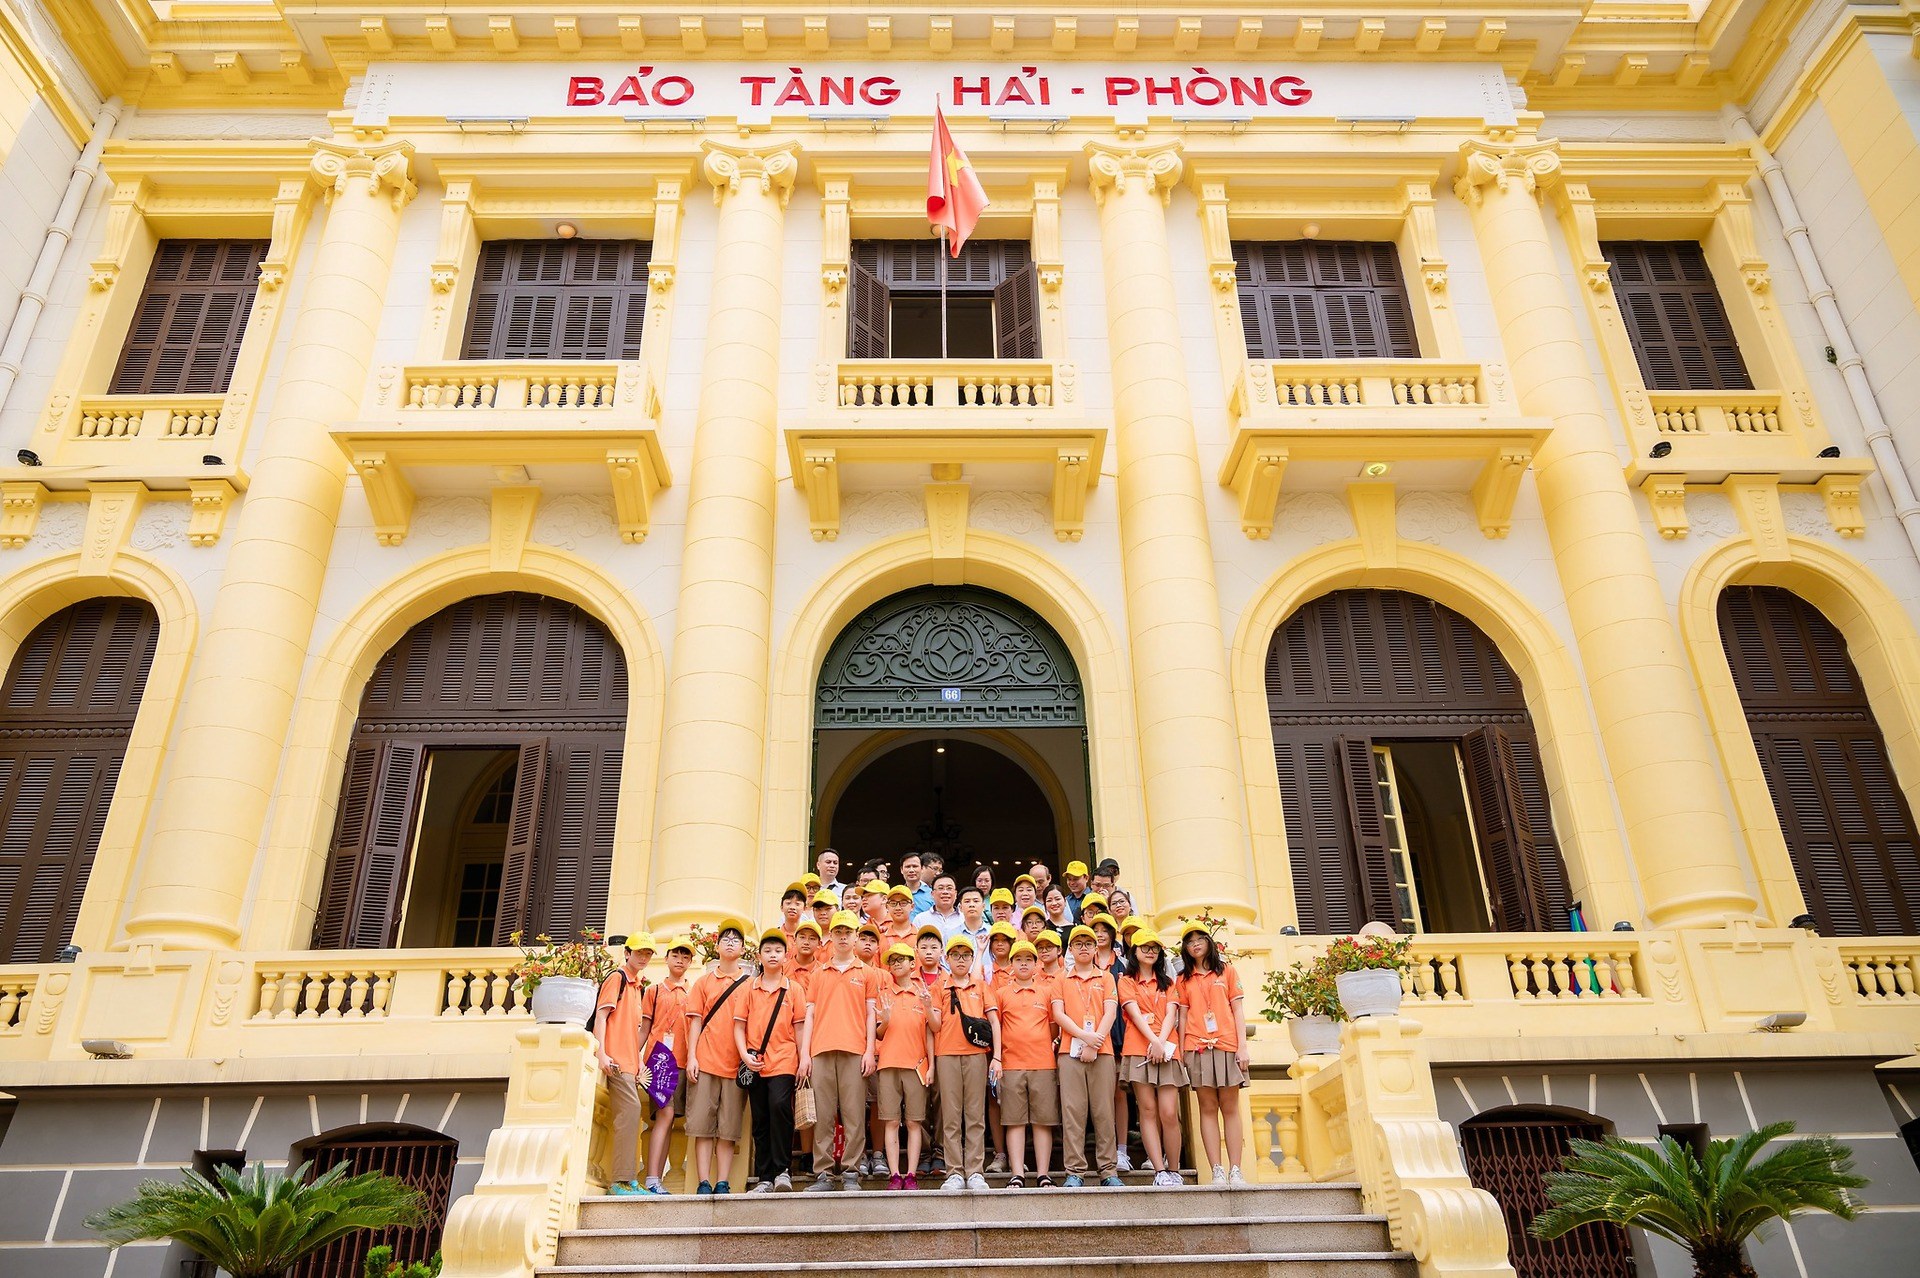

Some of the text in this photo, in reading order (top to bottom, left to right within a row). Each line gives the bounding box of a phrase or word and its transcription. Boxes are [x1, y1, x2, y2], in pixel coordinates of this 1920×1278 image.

[567, 66, 695, 106] BẢO
[740, 66, 902, 106] TÀNG
[953, 66, 1051, 106] HẢI
[1105, 66, 1313, 106] PHÒNG
[945, 690, 958, 700] 66
